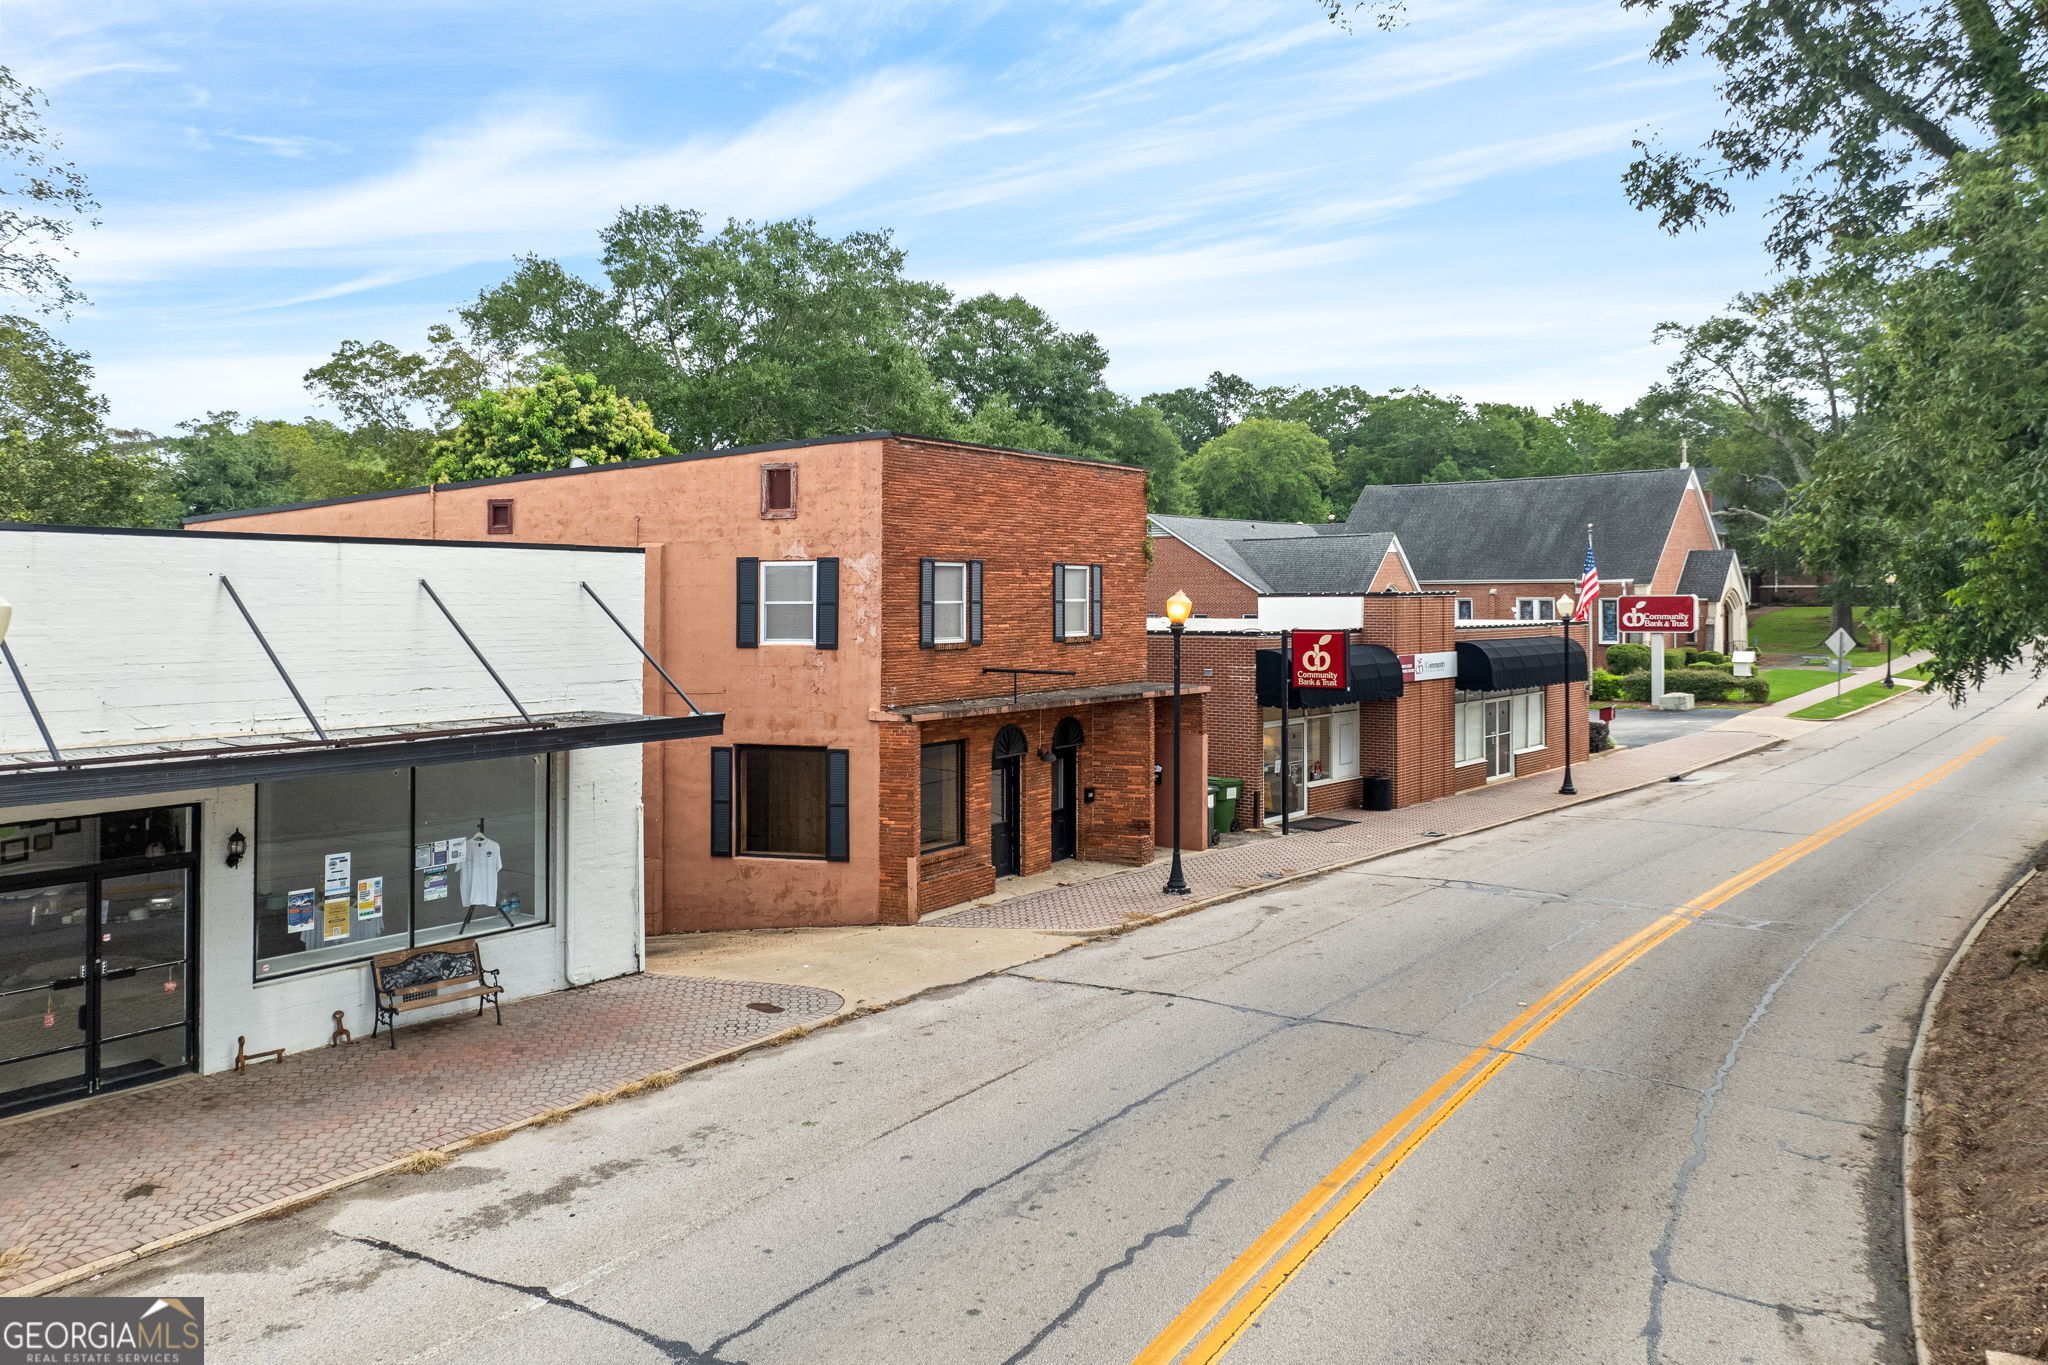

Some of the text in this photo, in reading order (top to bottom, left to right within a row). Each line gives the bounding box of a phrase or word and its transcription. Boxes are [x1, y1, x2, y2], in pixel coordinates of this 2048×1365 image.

[1644, 612, 1689, 622] Community
[1671, 619, 1689, 627] Trust
[1297, 670, 1338, 681] Community
[1298, 678, 1315, 686] Bank
